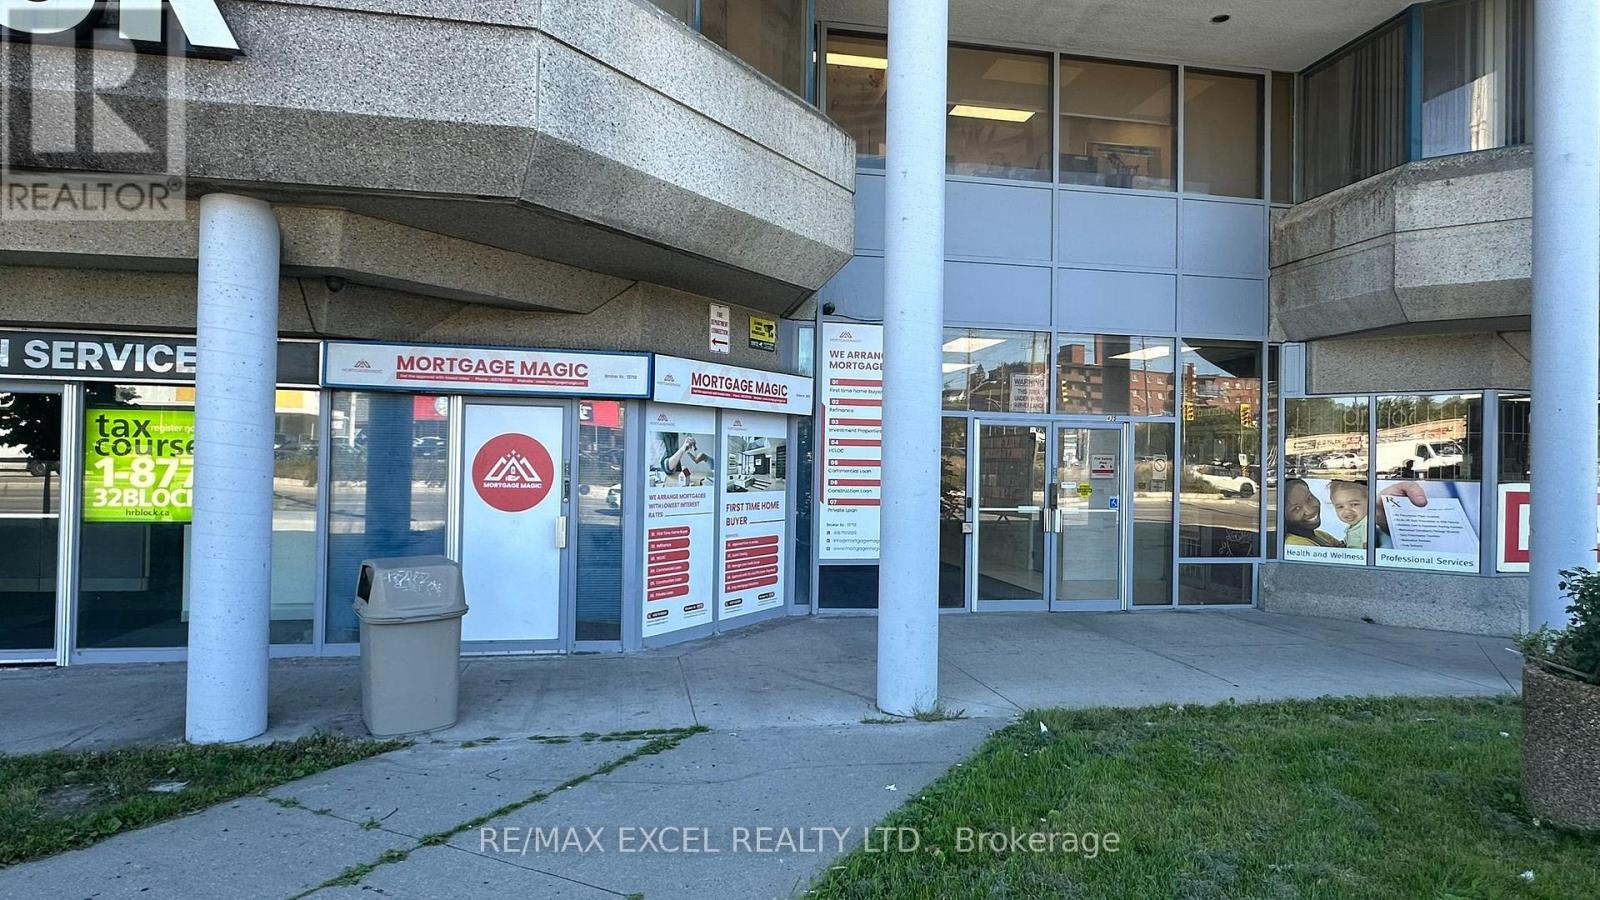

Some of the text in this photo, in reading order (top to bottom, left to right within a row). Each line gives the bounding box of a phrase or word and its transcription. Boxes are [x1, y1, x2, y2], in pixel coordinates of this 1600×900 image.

[829, 350, 883, 360] WE ARRAN
[397, 355, 589, 378] MORTGAGE MAGIC
[691, 372, 753, 393] MORTGAGE
[755, 381, 788, 397] MAGIC
[95, 414, 152, 438] tax
[94, 456, 194, 488] 1-877
[93, 488, 192, 508] 32BLOC
[125, 508, 170, 517] hrblock.ca
[726, 500, 780, 512] FIRST TIME HOME
[726, 516, 748, 526] BUYER
[1286, 549, 1364, 561] Health and Wellness
[1380, 553, 1474, 567] Professional Services
